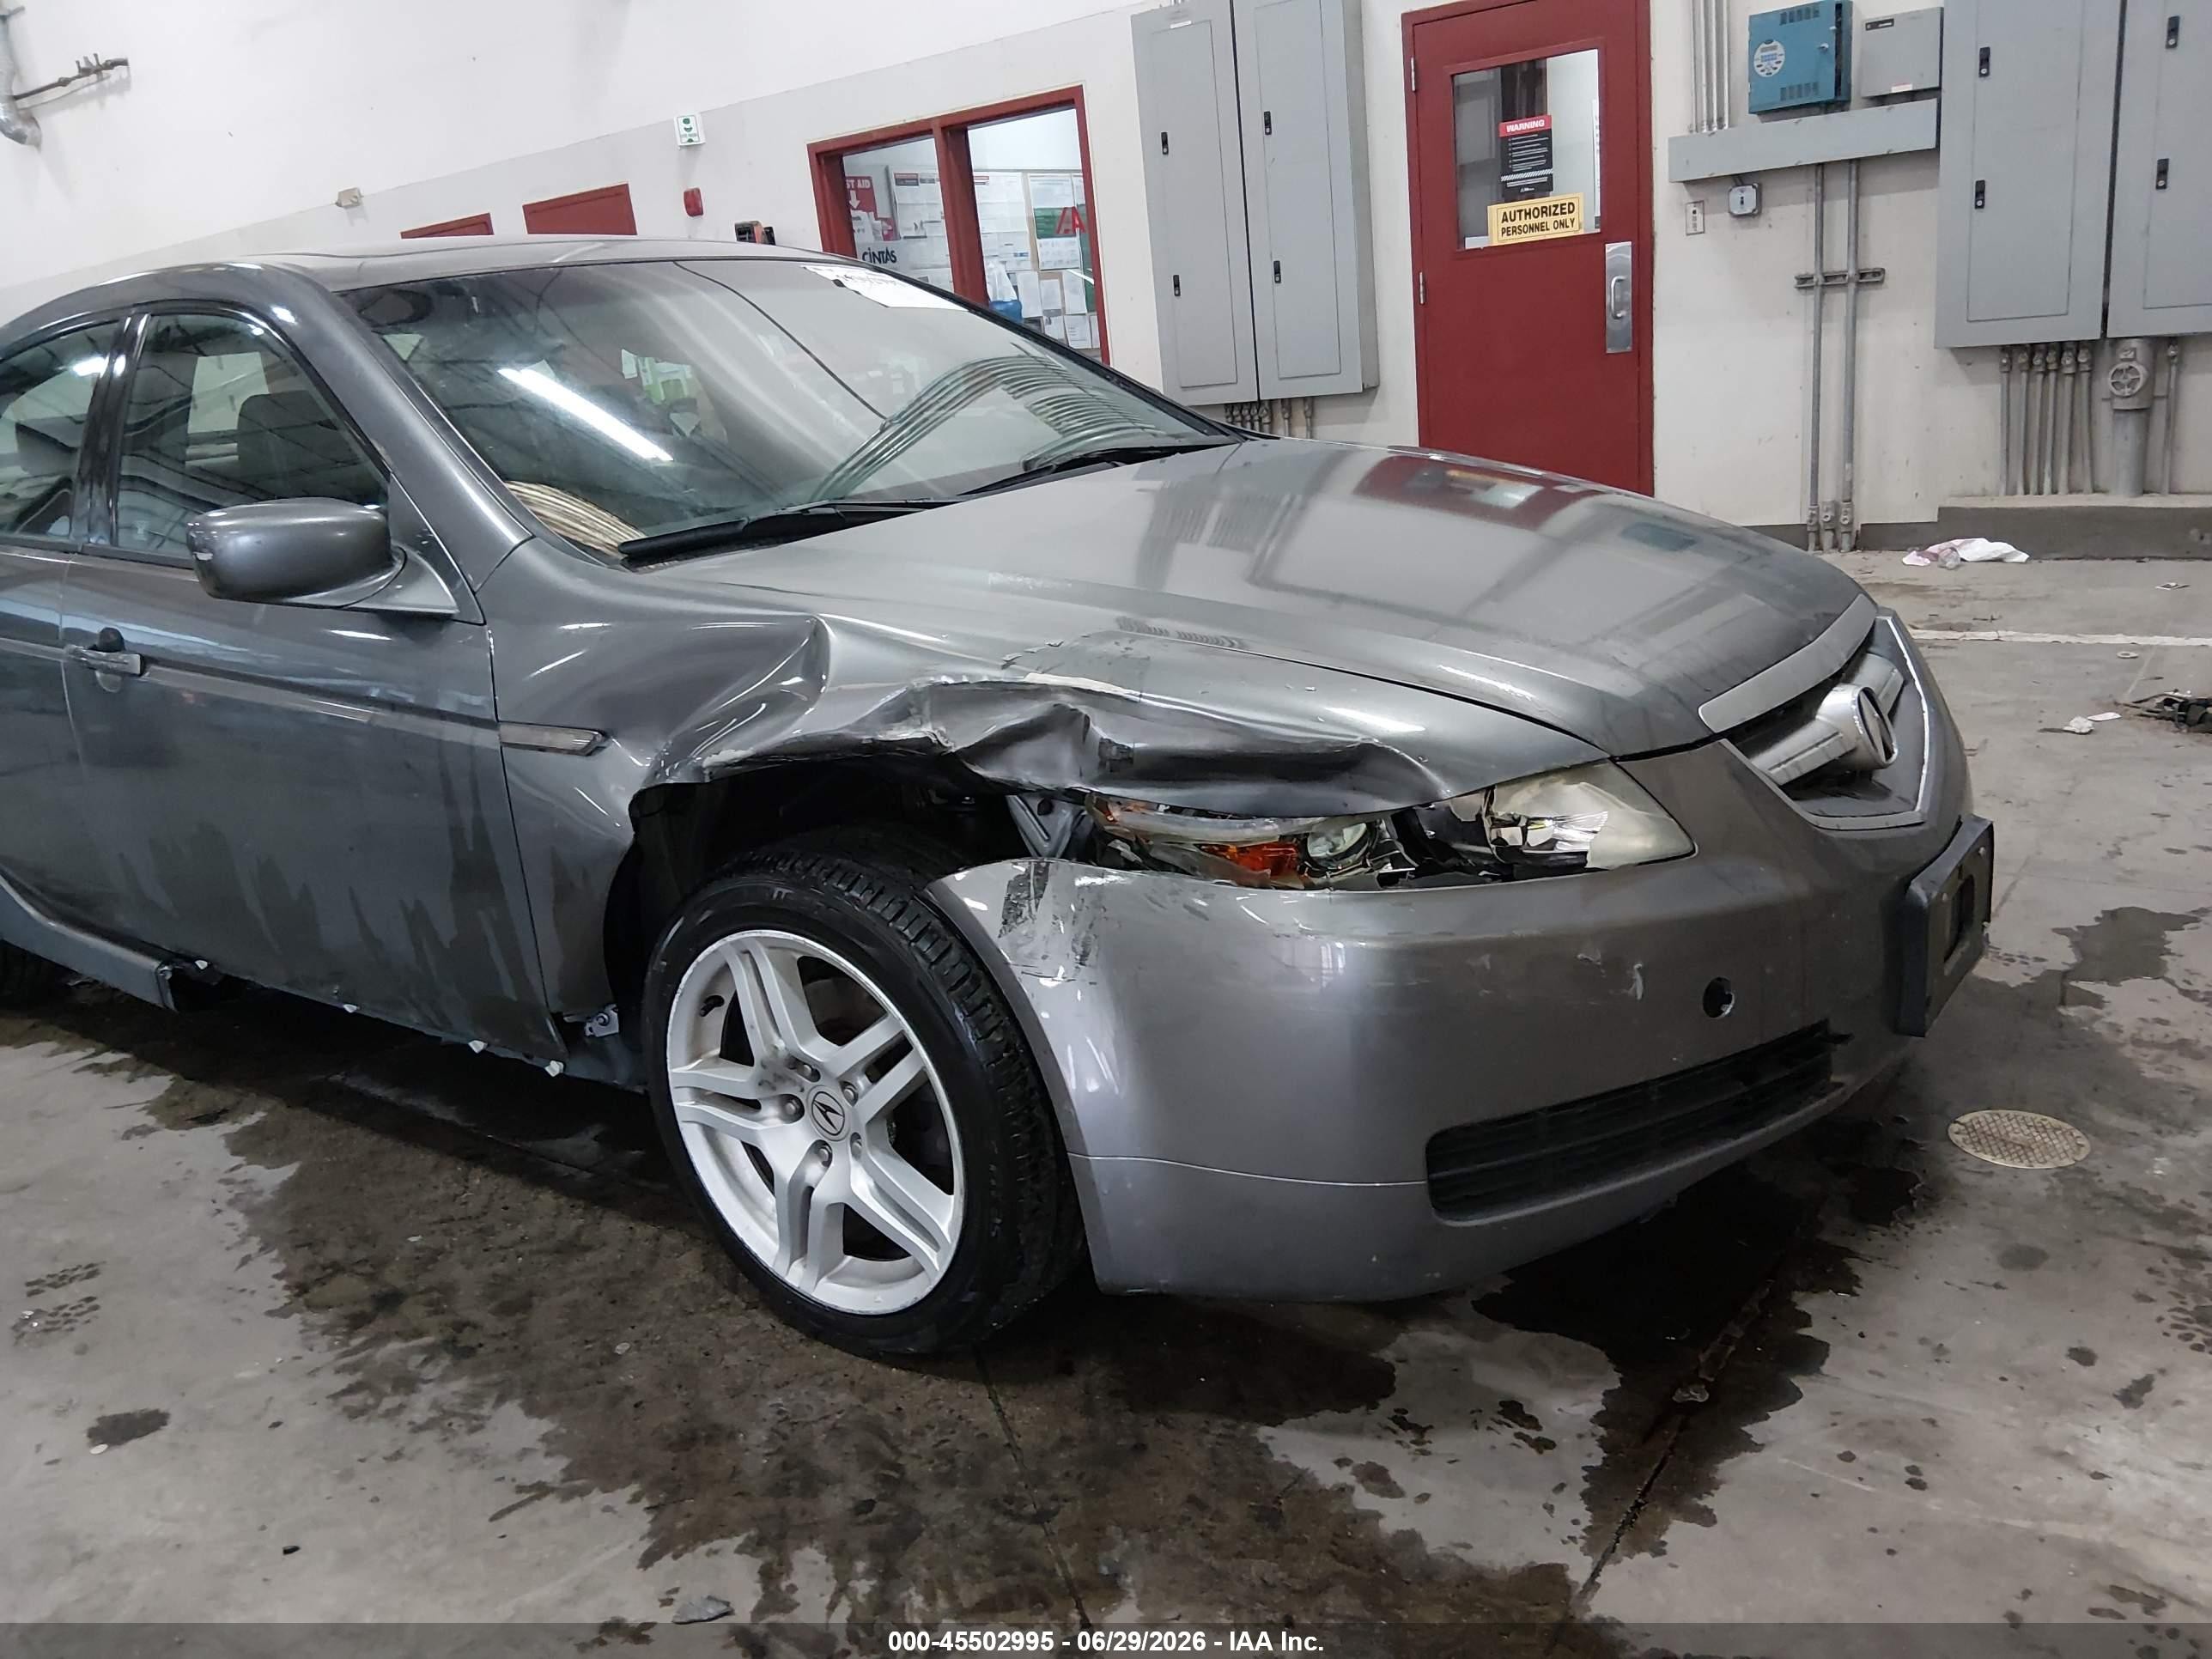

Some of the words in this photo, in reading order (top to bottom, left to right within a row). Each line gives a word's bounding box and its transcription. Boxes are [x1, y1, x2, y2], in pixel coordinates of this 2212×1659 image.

[1506, 119, 1545, 133] WARNING
[857, 179, 872, 189] AID
[1501, 202, 1576, 223] AUTHORIZED
[1501, 222, 1550, 237] PERSONNEL
[1553, 217, 1576, 229] ONLY
[861, 246, 897, 264] CINTAS
